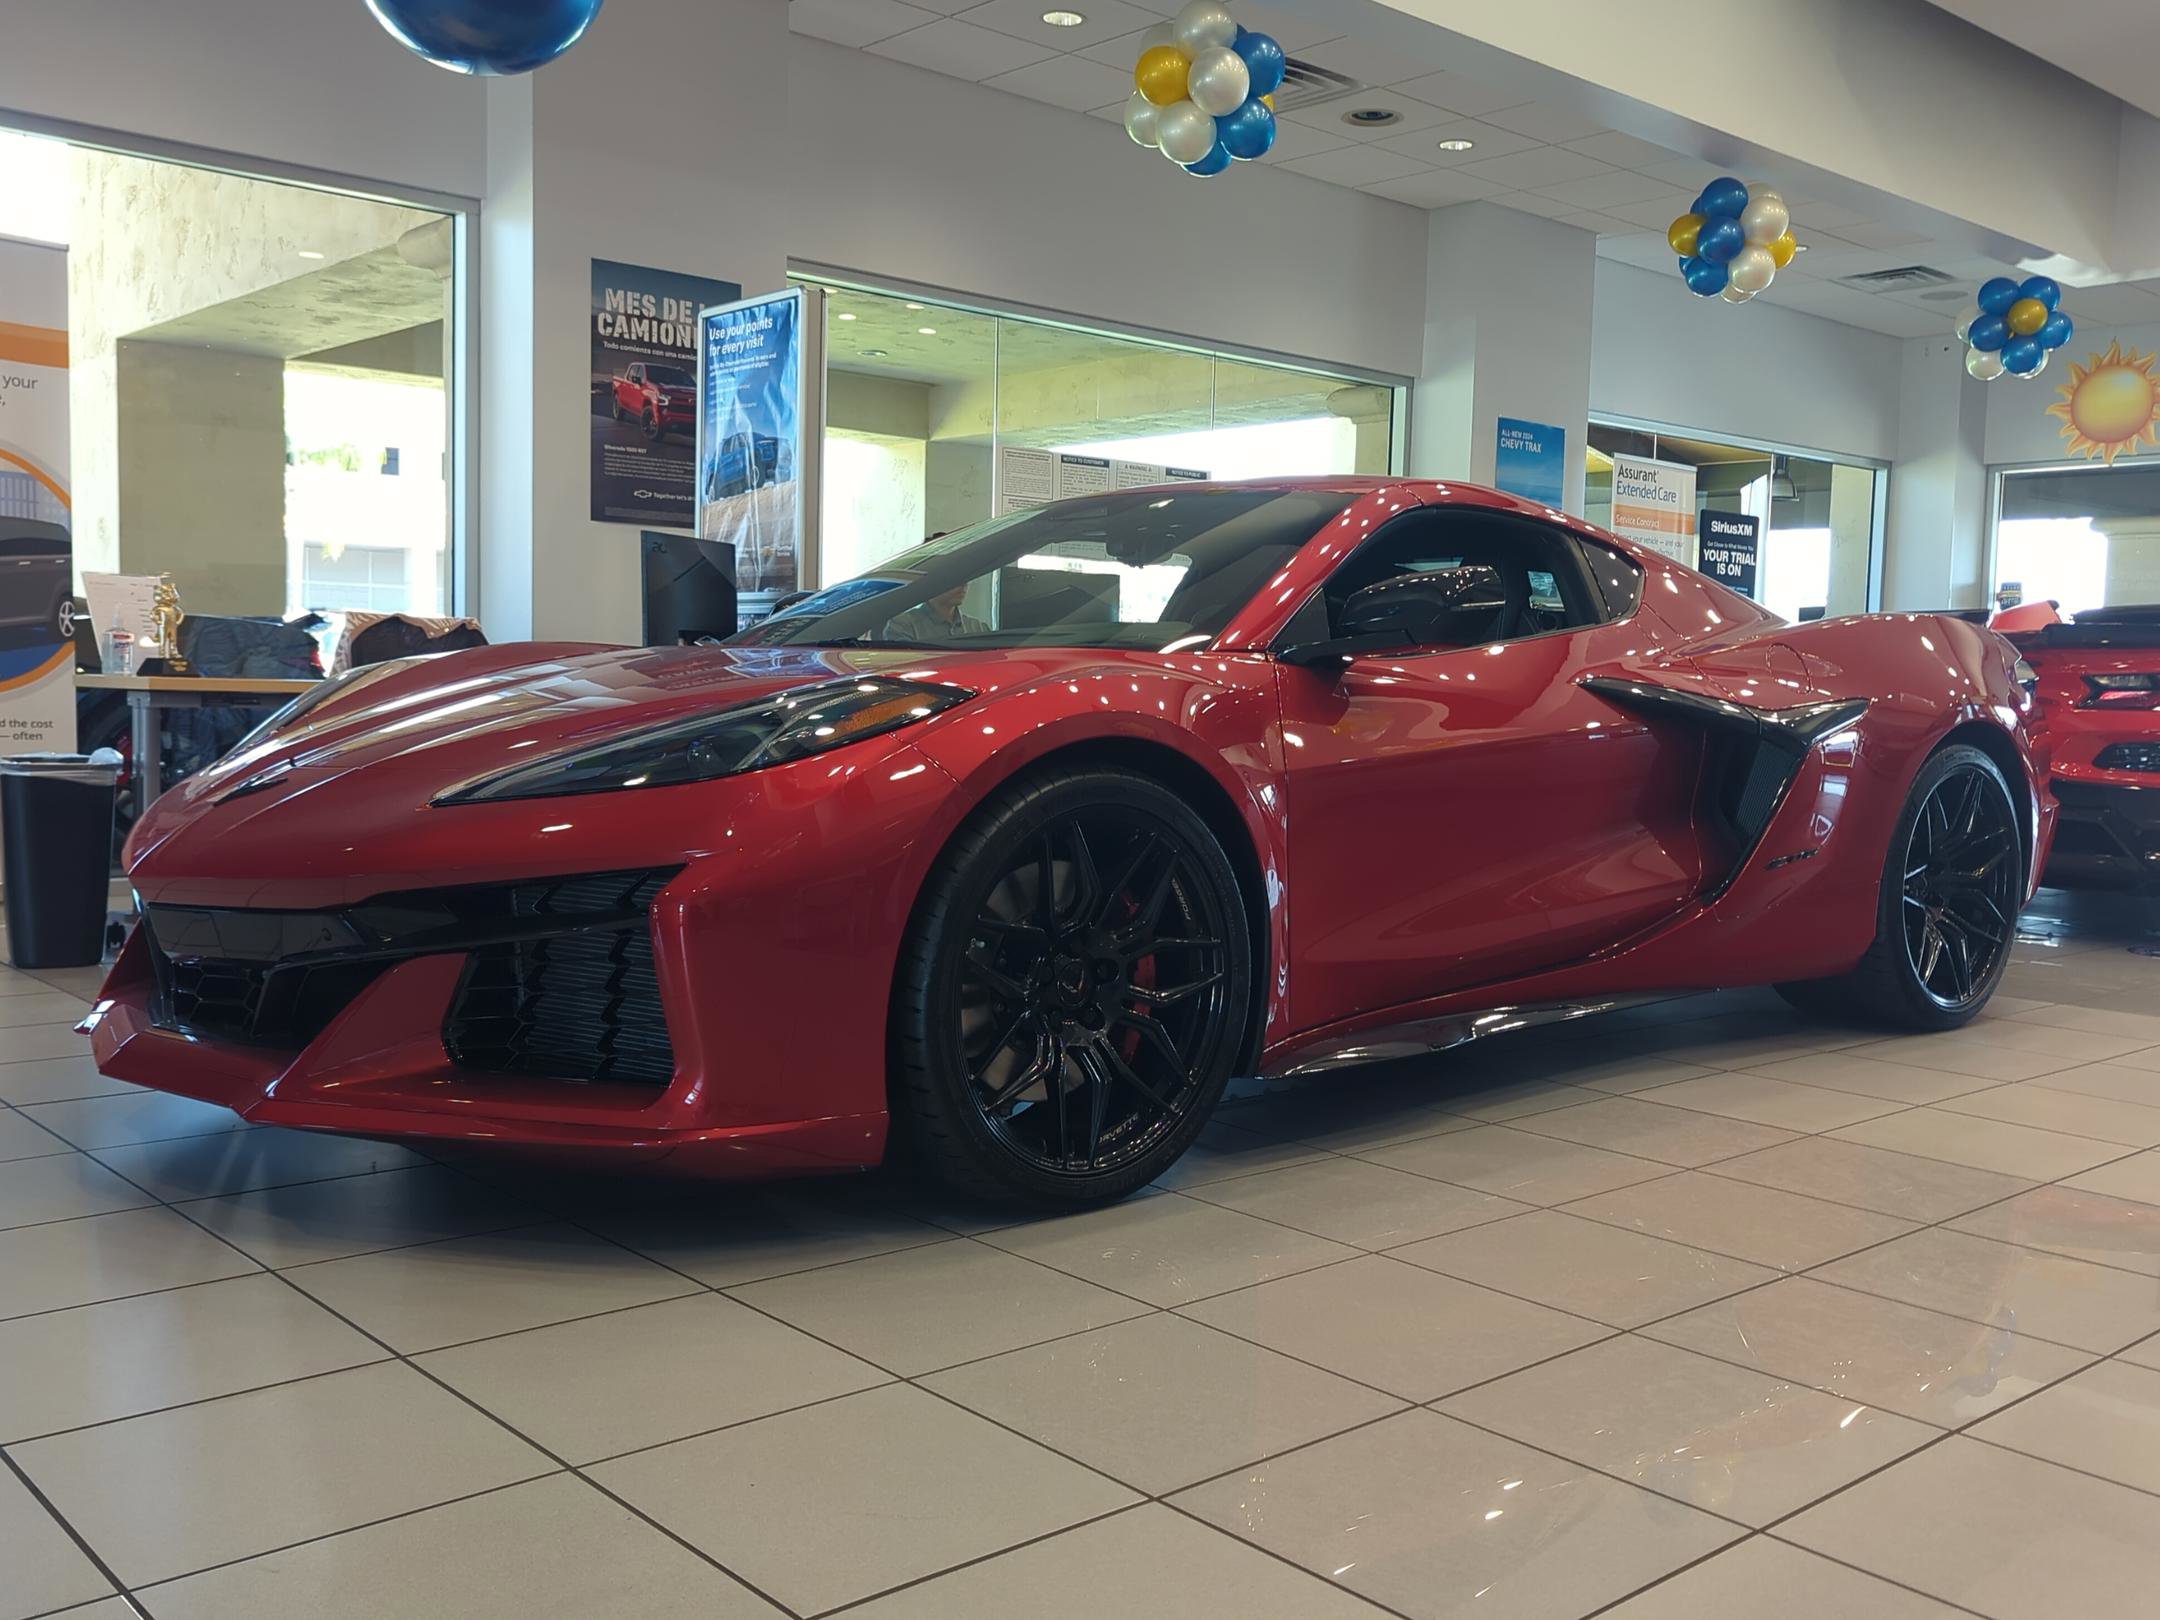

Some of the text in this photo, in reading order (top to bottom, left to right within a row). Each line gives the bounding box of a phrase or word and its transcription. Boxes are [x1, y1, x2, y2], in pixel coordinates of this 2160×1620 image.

[605, 287, 692, 324] MES DE
[709, 318, 773, 341] Use your points
[709, 334, 764, 357] for every visit
[2, 375, 38, 389] your
[1500, 437, 1542, 454] CHEVY TRAX
[1617, 463, 1657, 483] Assurant
[1616, 480, 1677, 503] Extended Care
[1615, 514, 1660, 529] Service Contract
[1710, 520, 1753, 537] SiriusXM
[1703, 549, 1756, 566] YOUR TRIAL
[1716, 562, 1742, 576] IS ON
[9, 719, 28, 728] the
[30, 720, 54, 728] cost
[12, 731, 43, 740] often
